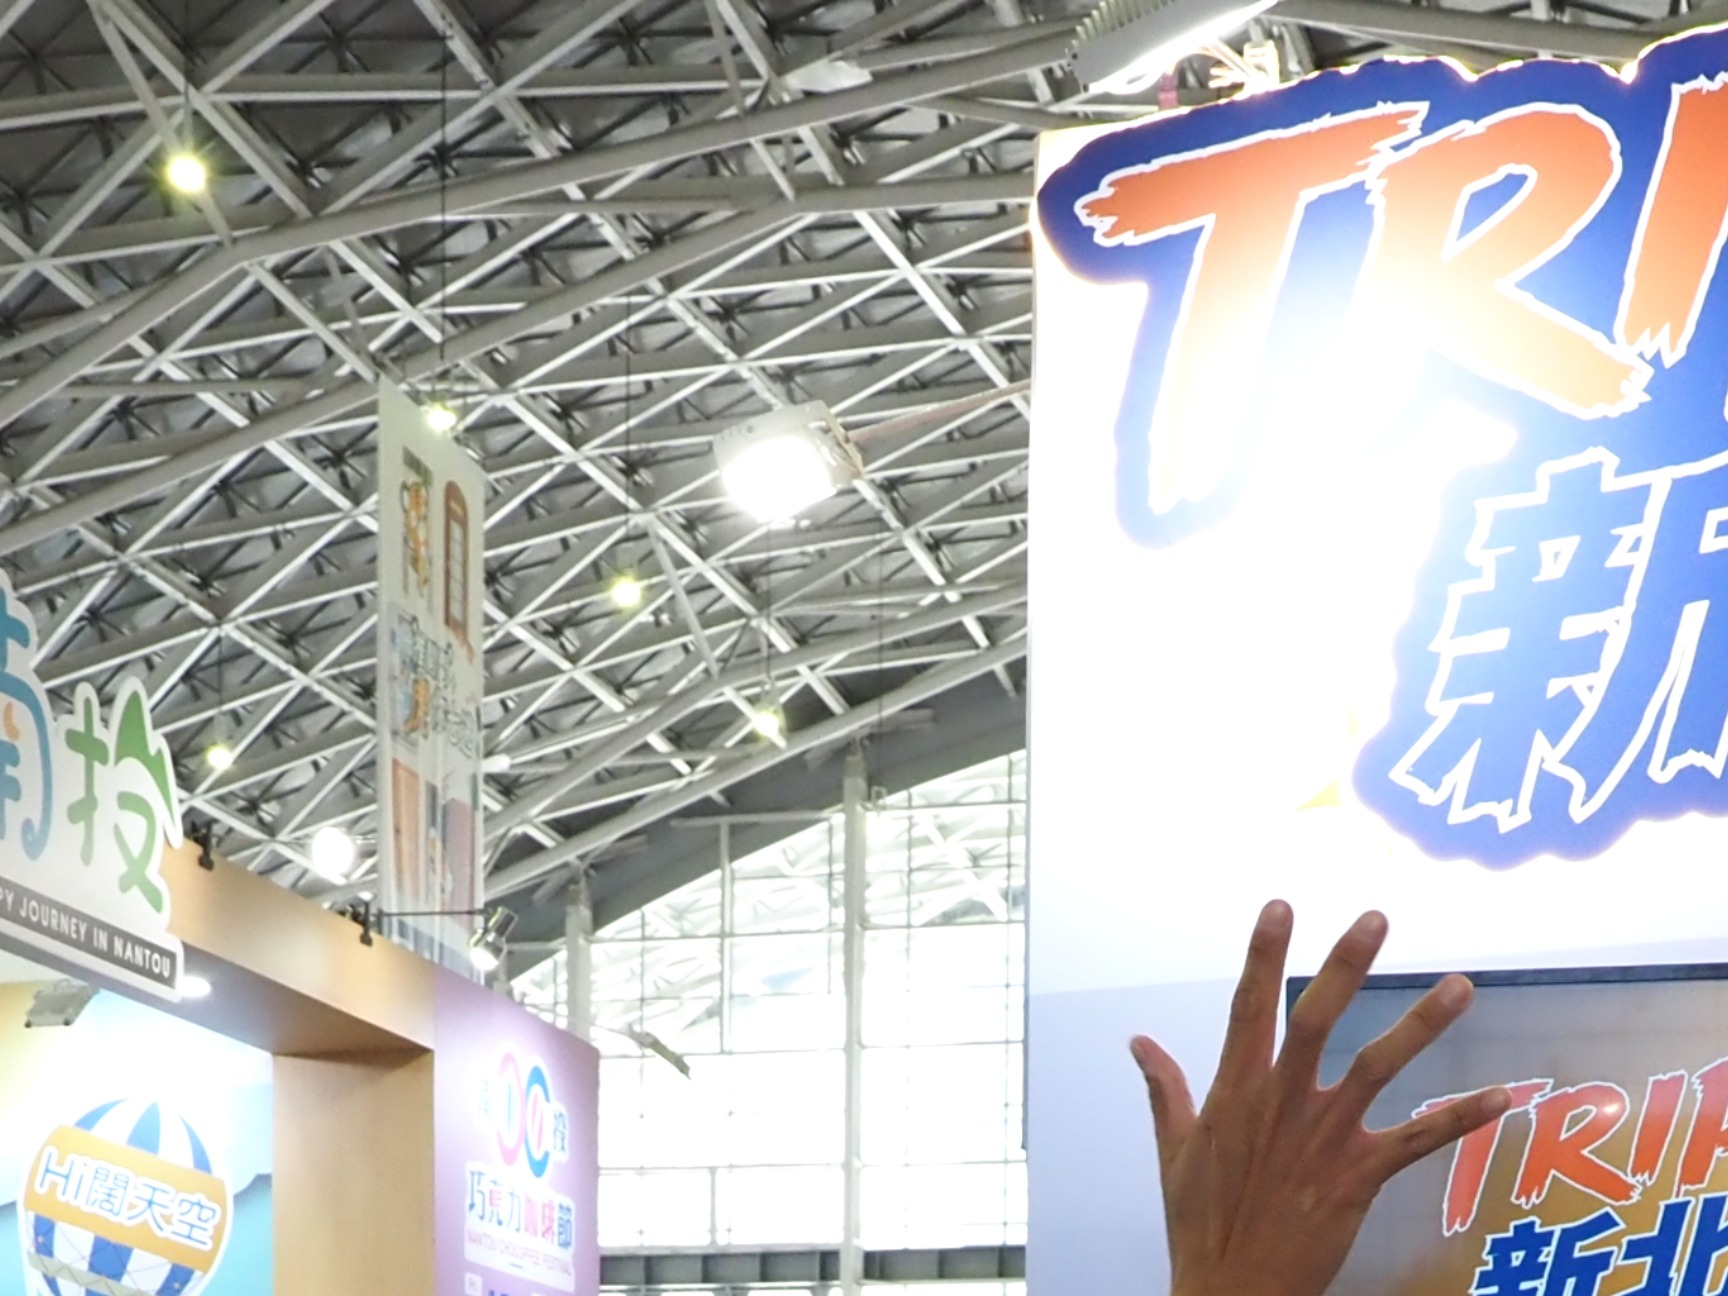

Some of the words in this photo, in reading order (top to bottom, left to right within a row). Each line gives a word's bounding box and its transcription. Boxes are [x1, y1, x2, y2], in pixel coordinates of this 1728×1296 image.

[19, 899, 88, 942] JOURNEY
[93, 926, 109, 952] IN
[113, 937, 172, 978] NANTOU
